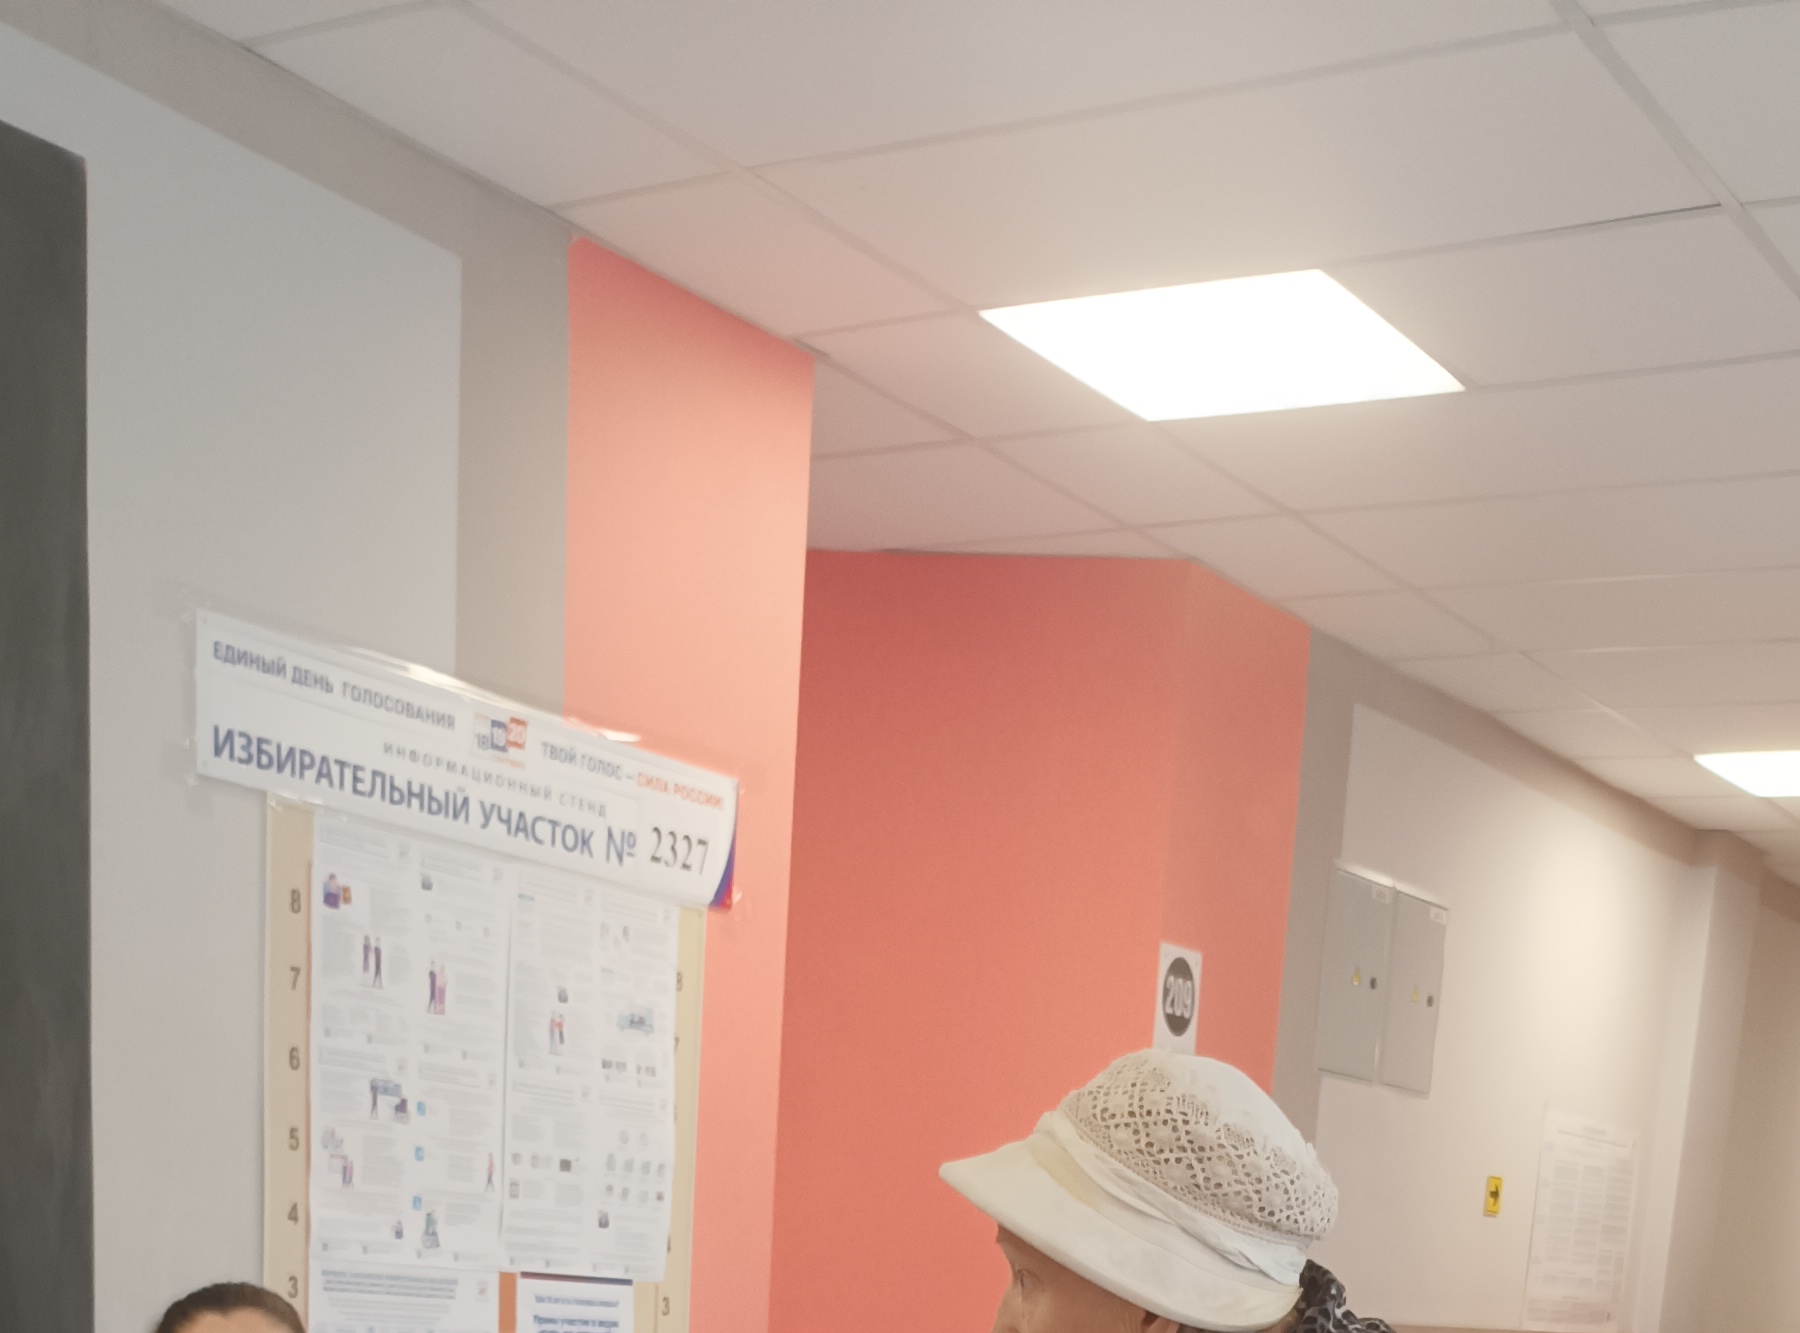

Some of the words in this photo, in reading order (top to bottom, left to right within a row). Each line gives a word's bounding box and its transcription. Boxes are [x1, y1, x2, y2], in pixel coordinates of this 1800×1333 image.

[213, 640, 287, 678] ЕДИНЫЙ
[290, 665, 334, 694] ДЕНЬ
[341, 681, 456, 731] ГОЛОСОВАНИЯ
[383, 741, 553, 801] ИНФОРМАЦИОННЫЙ
[559, 792, 607, 818] СТЕНД
[541, 741, 577, 765] ТВОЙ
[580, 753, 623, 780] ГОЛОС
[636, 771, 669, 793] СИЛА
[673, 782, 722, 807] РОССИИ
[213, 723, 470, 825] ИЗБИРАТЕЛЬНЫЙ
[478, 799, 595, 859] УЧАСТОК
[605, 825, 637, 867] №
[650, 826, 709, 875] 2327
[290, 888, 301, 914] 8
[290, 966, 300, 991] 7
[1165, 975, 1192, 1020] 209
[288, 1046, 300, 1071] 6
[288, 1127, 300, 1151] 5
[287, 1202, 299, 1225] 4
[288, 1275, 298, 1299] 3
[661, 1296, 671, 1317] 3
